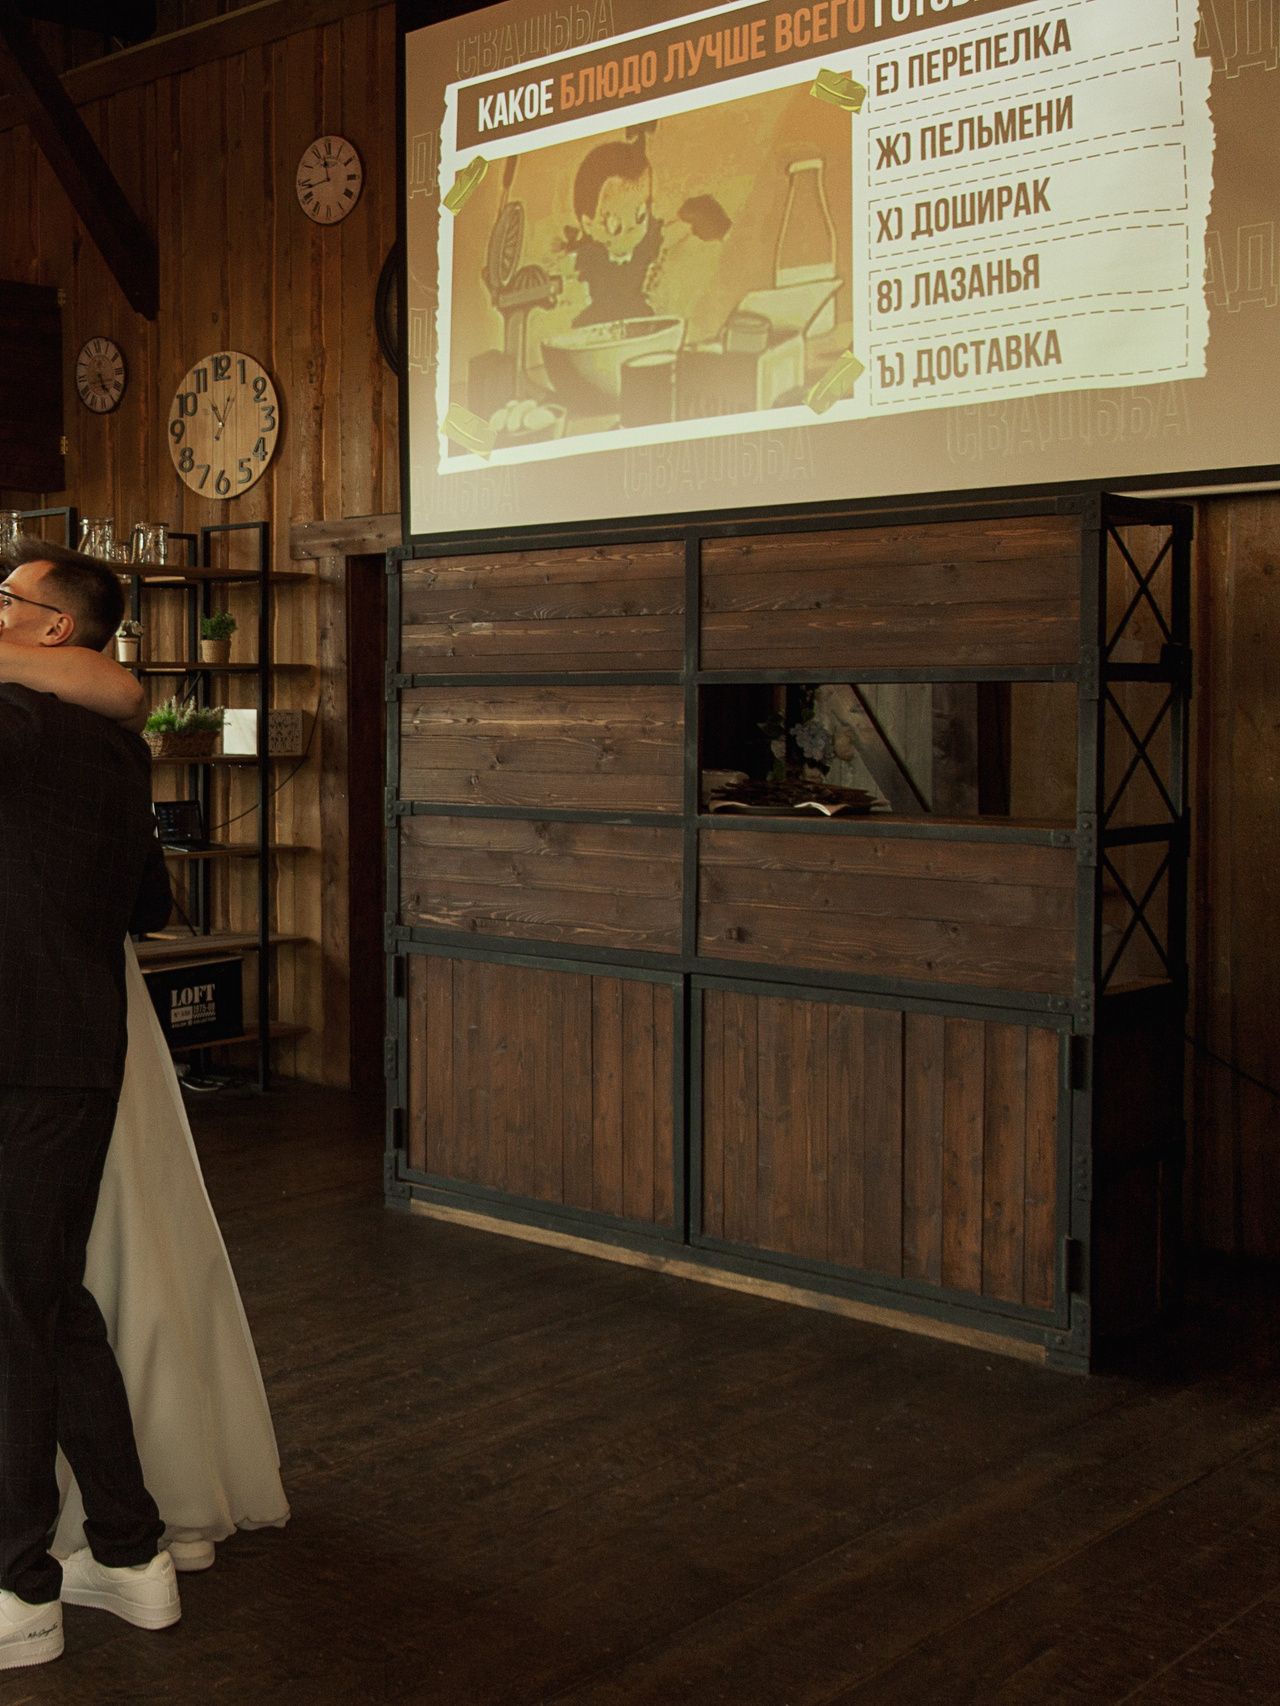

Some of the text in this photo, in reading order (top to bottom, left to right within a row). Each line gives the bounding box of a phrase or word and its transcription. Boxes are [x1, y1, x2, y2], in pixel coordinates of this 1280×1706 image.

[478, 78, 554, 133] КАКОЕ
[560, 50, 657, 110] БЛЮДО
[663, 19, 767, 83] ЛУЧШЕ
[775, 0, 866, 53] ВСЕГО
[876, 18, 1072, 97] Е) ПЕРЕПЕЛКА
[875, 94, 1073, 171] Ж) ПЕЛЬМЕНИ
[876, 176, 1052, 244] Х) ДОШИРАК
[876, 253, 1040, 314] 8) ЛАЗАНЬЯ
[211, 355, 231, 381] 12
[237, 359, 245, 384] 1
[876, 329, 1062, 389] Ъ) ДОСТАВКА
[193, 367, 208, 394] 11
[252, 377, 267, 403] 2
[176, 392, 198, 418] 10
[170, 419, 185, 444] 9
[260, 405, 276, 432] 3
[178, 447, 195, 473] 8
[252, 437, 268, 461] 4
[195, 464, 211, 489] 7
[215, 470, 231, 495] 6
[237, 457, 252, 484] 5
[170, 983, 216, 1007] LOFT
